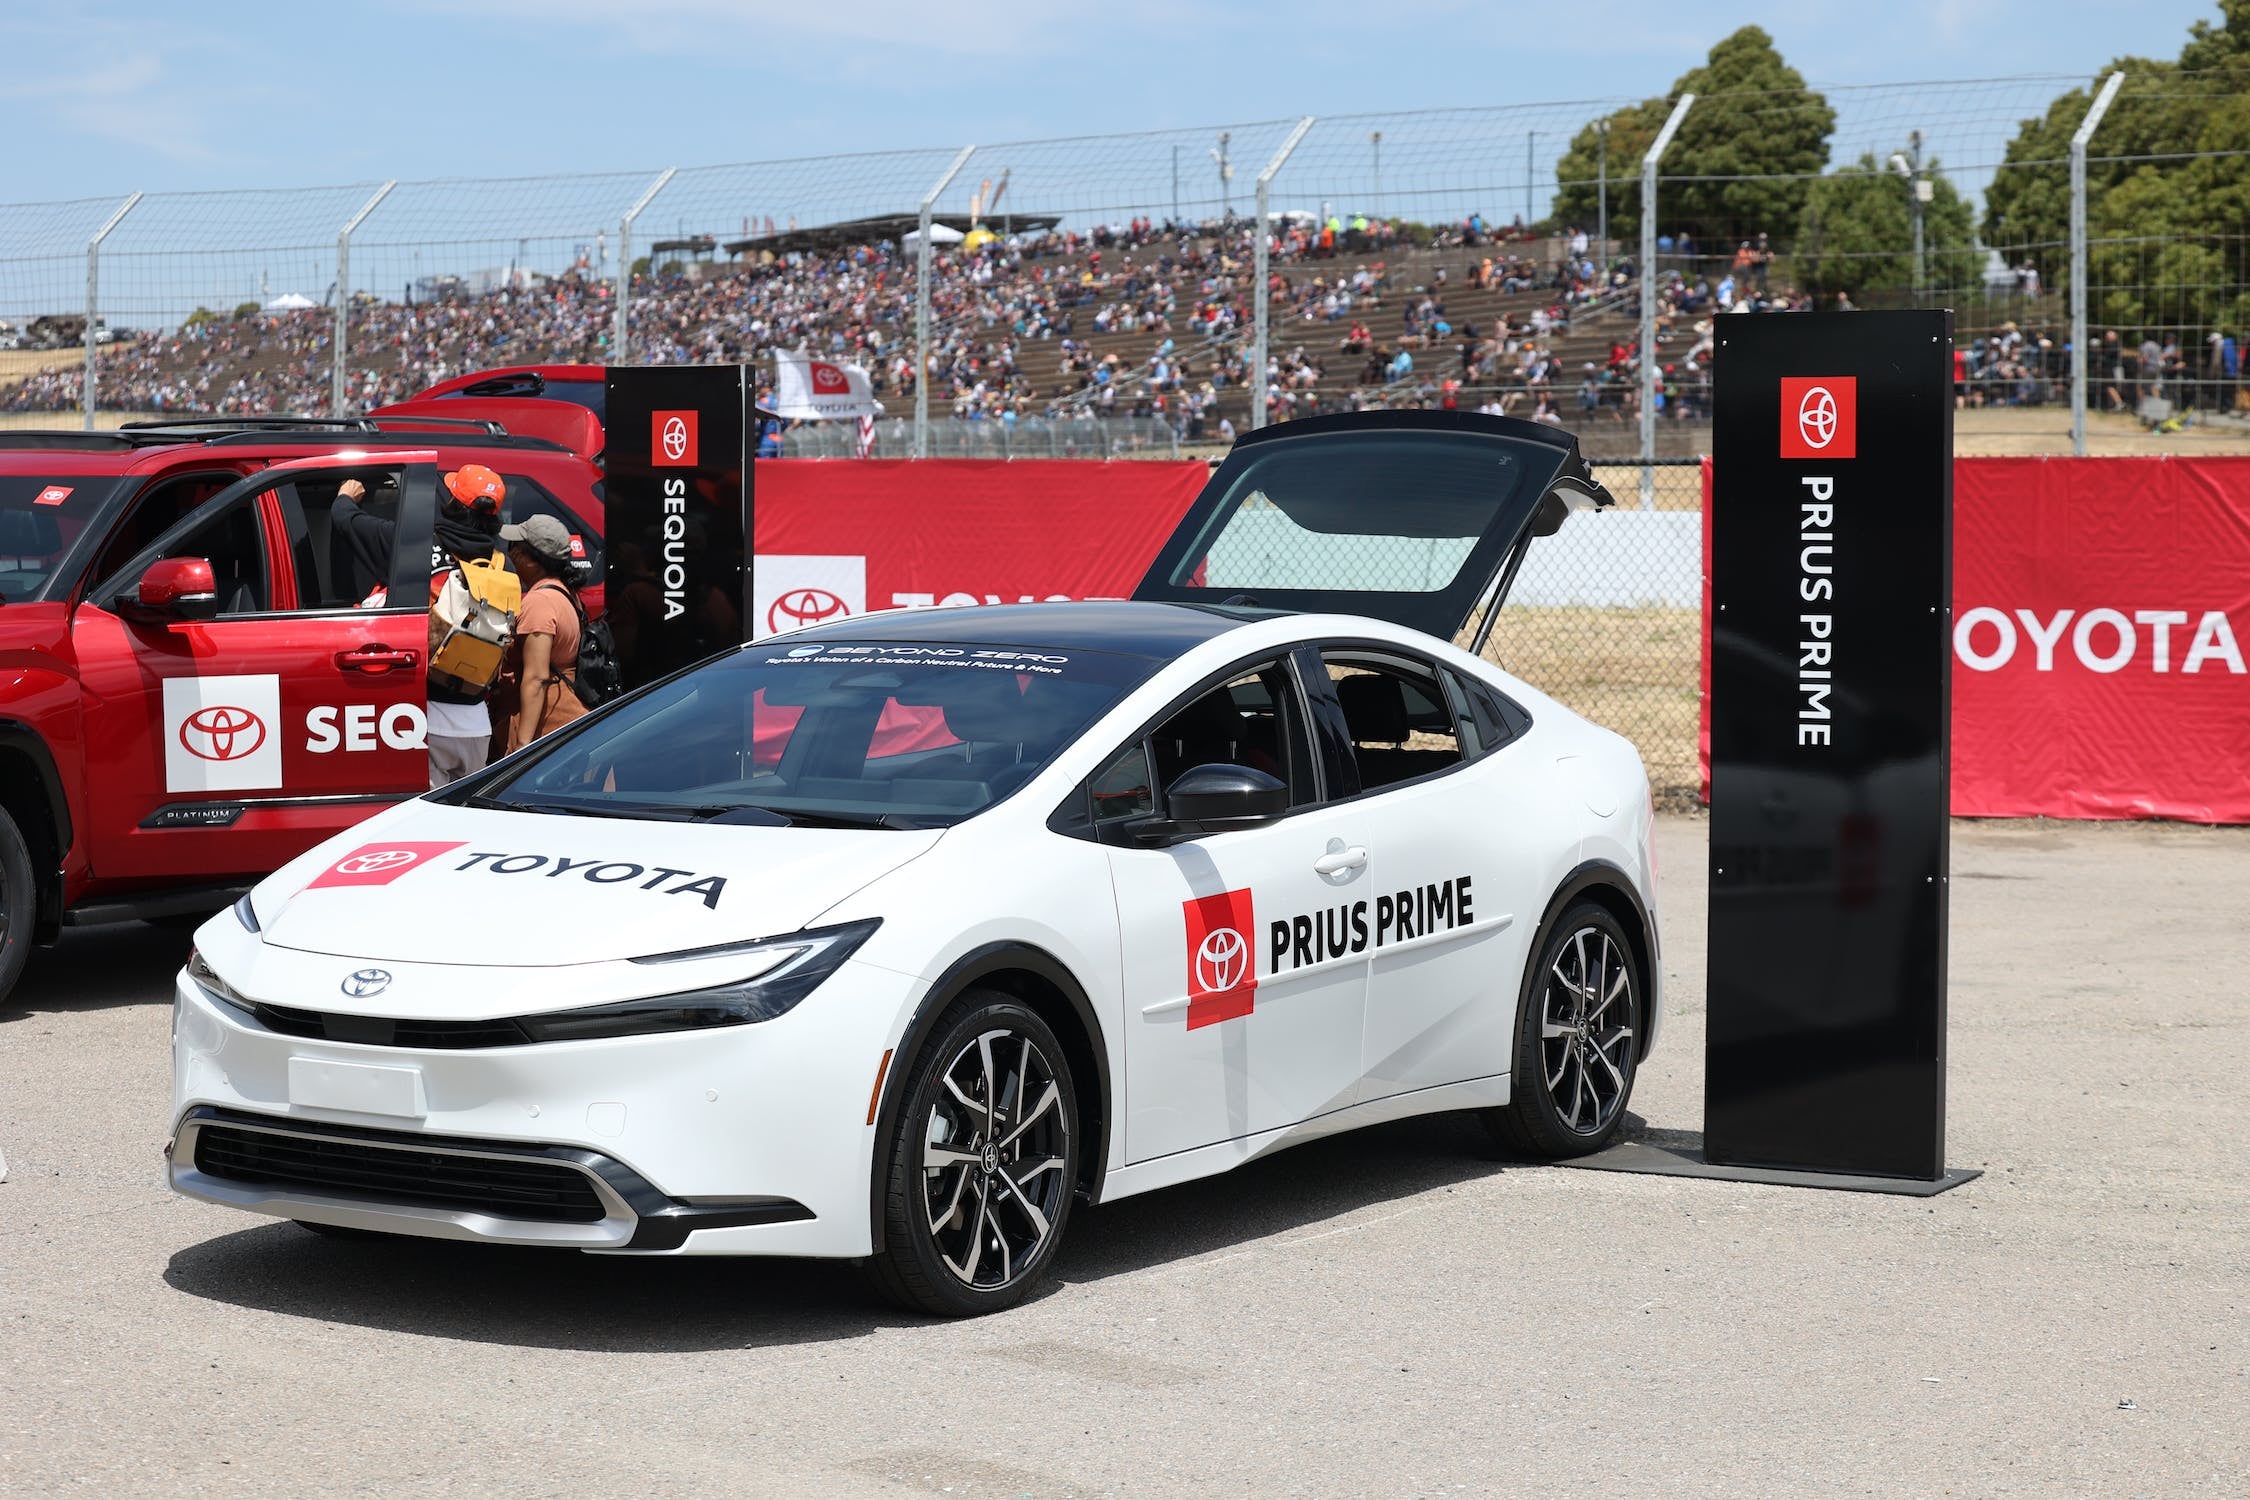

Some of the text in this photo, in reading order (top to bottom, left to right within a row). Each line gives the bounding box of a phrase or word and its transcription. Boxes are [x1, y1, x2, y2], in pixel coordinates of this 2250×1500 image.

[808, 403, 857, 412] TOYOTA
[663, 478, 686, 621] SEQUOIA
[1798, 476, 1834, 746] PRIUS PRIME
[1952, 606, 2249, 674] OYOTA
[765, 656, 812, 666] Toyota's
[875, 657, 922, 665] Carbon
[922, 659, 972, 668] Neutral
[971, 660, 1014, 670] Future
[1014, 662, 1026, 671] &
[1027, 664, 1063, 674] More
[826, 646, 1069, 664] BEYOND ZERO
[167, 810, 231, 819] PLATINUM
[454, 852, 728, 911] TOYOTA
[1270, 875, 1474, 975] PRIUS PRIME
